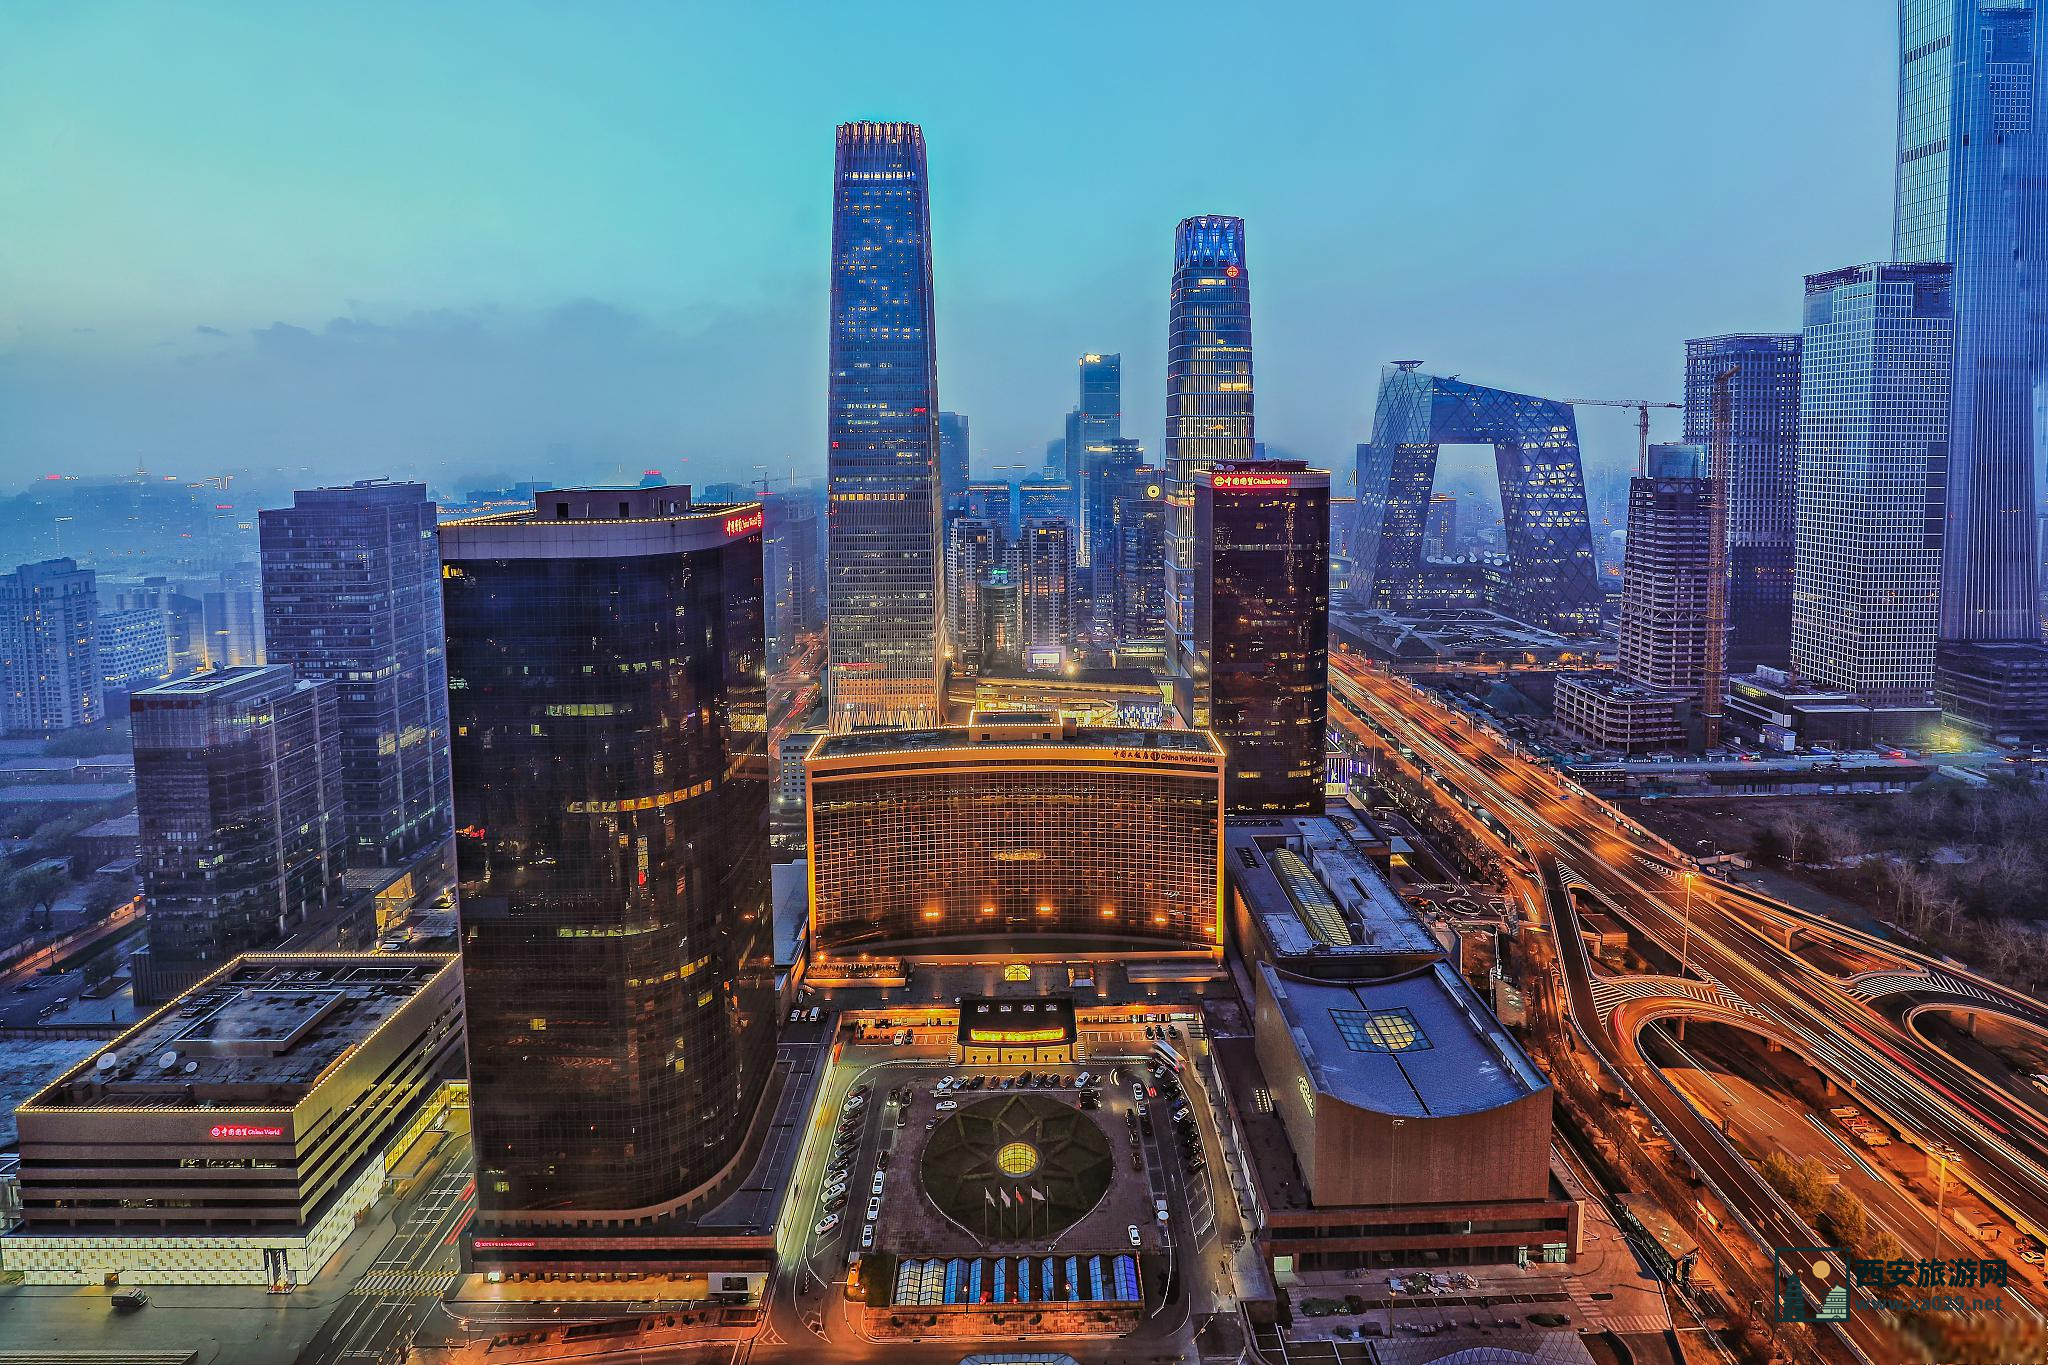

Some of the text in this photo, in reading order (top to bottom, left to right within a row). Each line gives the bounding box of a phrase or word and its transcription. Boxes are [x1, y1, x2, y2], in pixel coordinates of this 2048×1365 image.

[1271, 477, 1288, 485] World
[1161, 753, 1178, 761] China
[1179, 755, 1198, 763] World
[1199, 756, 1216, 764] Hotel
[247, 1128, 264, 1136] China
[263, 1128, 281, 1136] World
